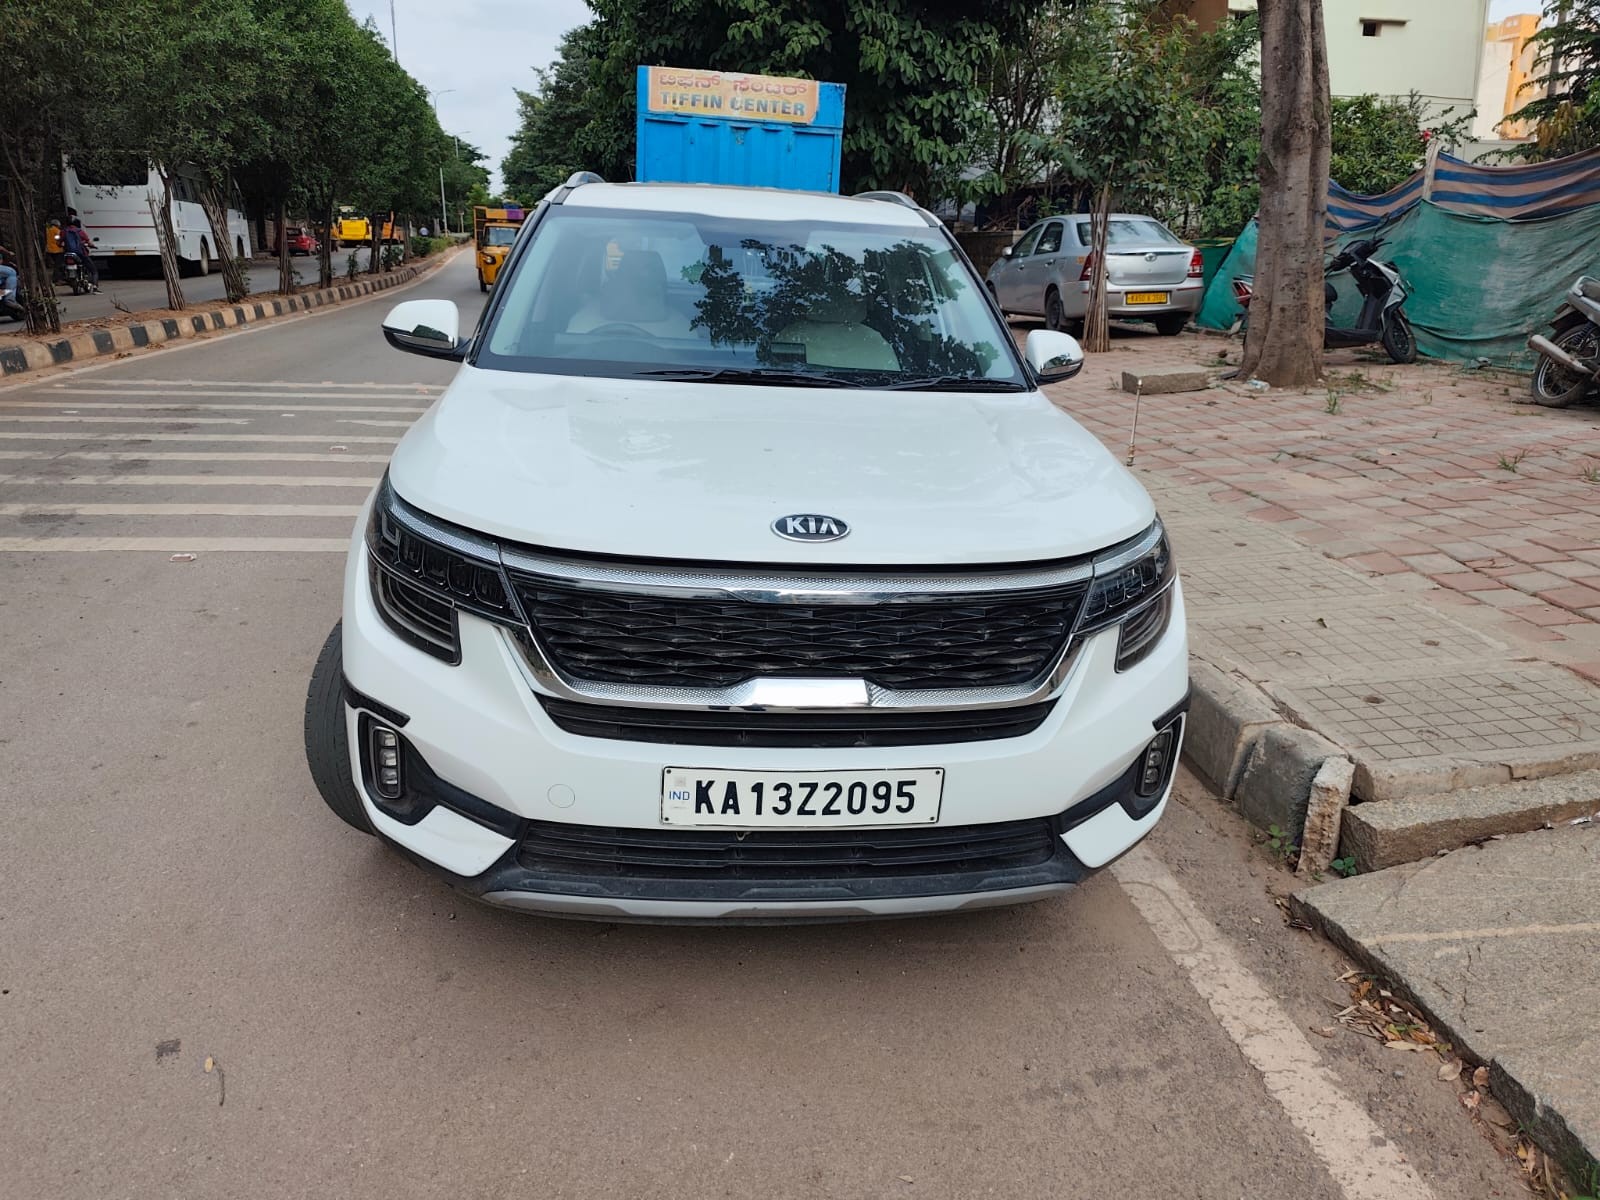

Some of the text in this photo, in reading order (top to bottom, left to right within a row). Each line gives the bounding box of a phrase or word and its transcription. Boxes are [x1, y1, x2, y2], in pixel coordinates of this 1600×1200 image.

[660, 91, 806, 116] TIFFIN CENTER
[785, 515, 840, 535] KIA
[668, 791, 690, 801] IND
[694, 779, 918, 816] KA13Z2095
